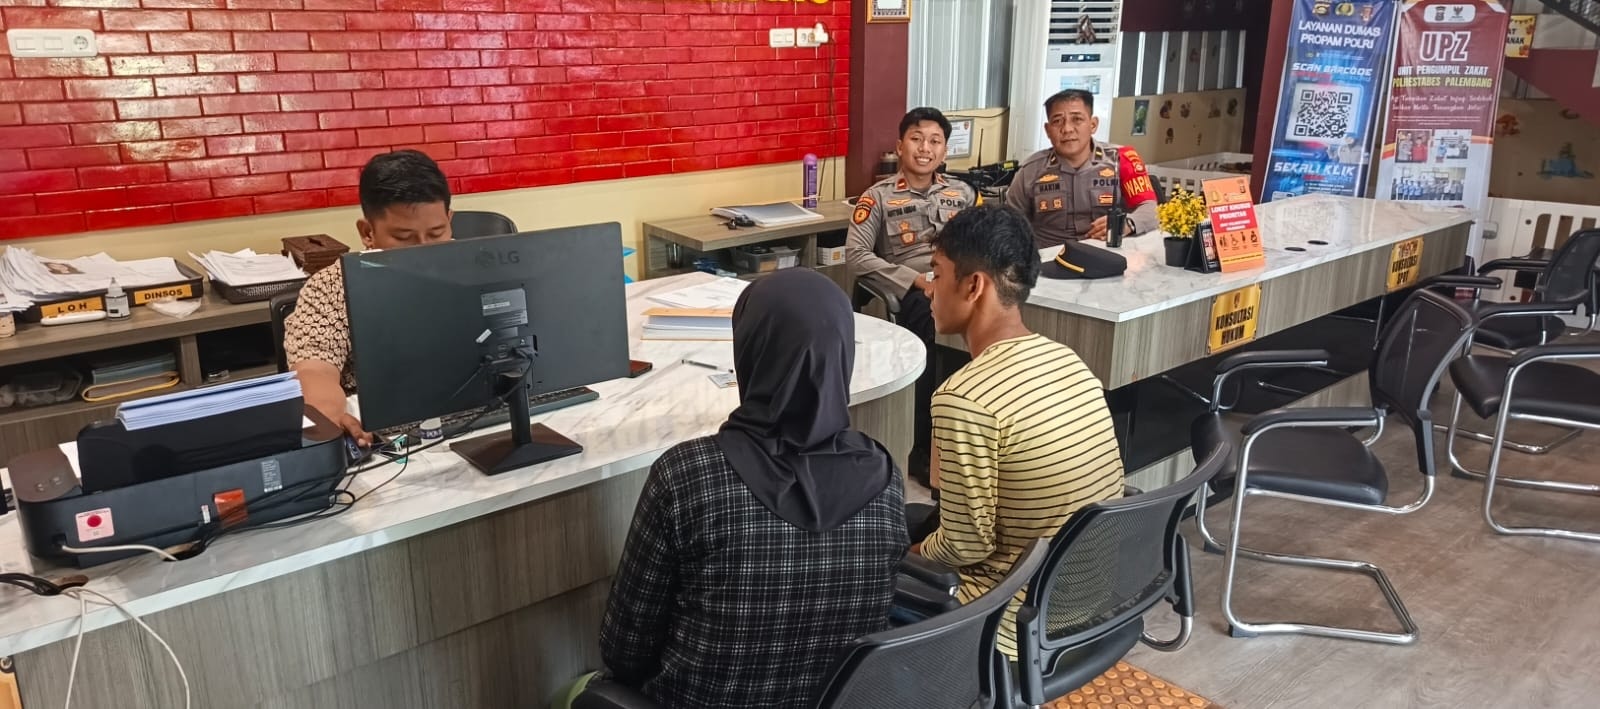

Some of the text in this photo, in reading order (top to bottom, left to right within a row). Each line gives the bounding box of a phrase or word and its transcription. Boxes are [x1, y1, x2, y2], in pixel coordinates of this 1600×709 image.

[1298, 20, 1381, 37] LAYANAN DUMAS
[1300, 33, 1374, 49] PROPAM POLRI
[1420, 31, 1471, 61] UPZ
[1292, 62, 1373, 76] SCAN BARCODE
[1397, 65, 1489, 76] UNIT PENGUMPUL ZAKAT
[1392, 77, 1493, 88] POLRESTABES PALEMBANG
[1274, 161, 1356, 176] SEKALI KLIK
[498, 250, 520, 264] LG
[144, 288, 184, 301] DINSOS
[1215, 305, 1255, 331] KONSULTASI
[1221, 325, 1245, 345] HUKUM
